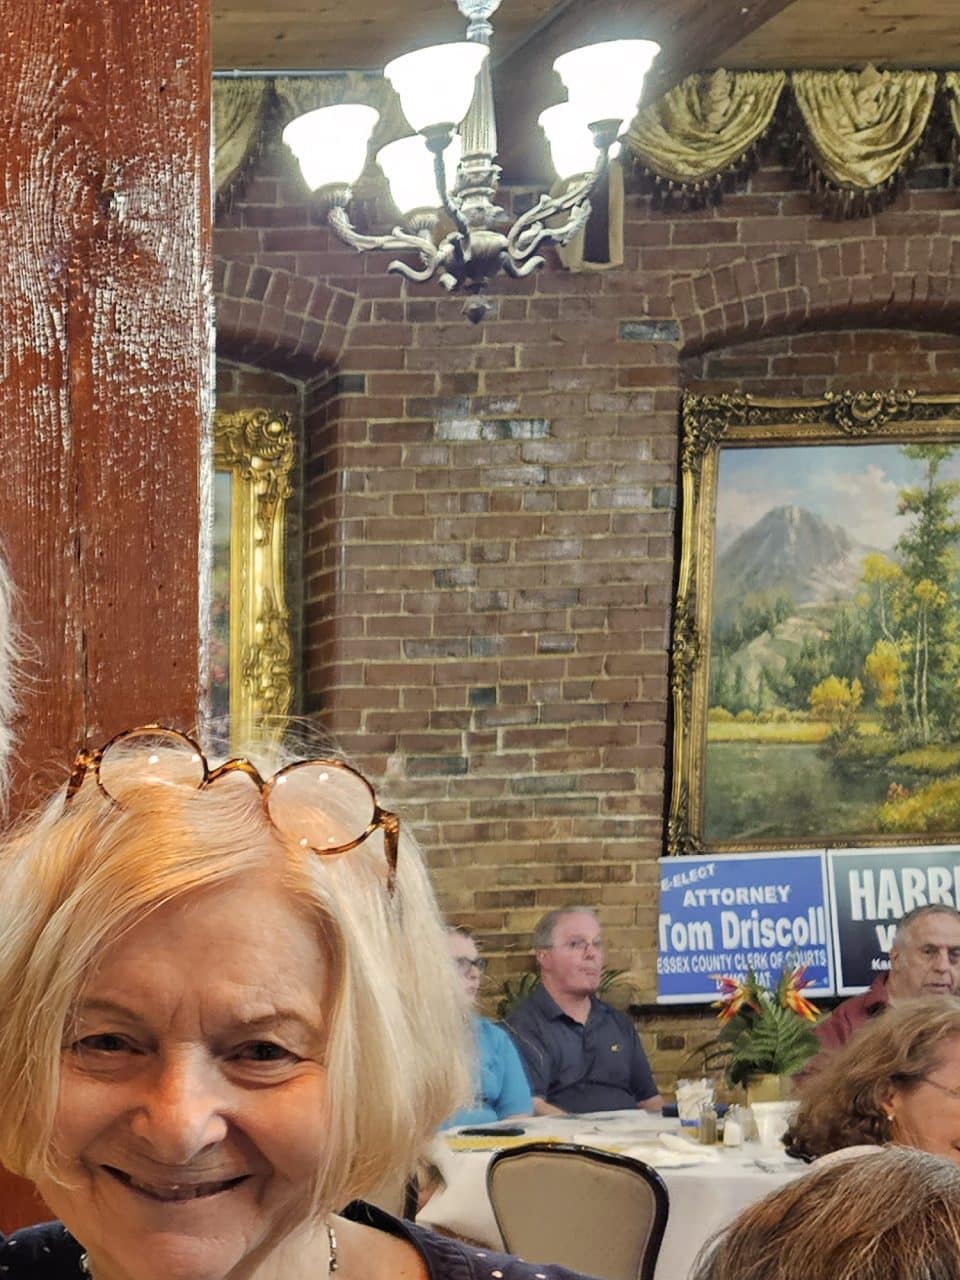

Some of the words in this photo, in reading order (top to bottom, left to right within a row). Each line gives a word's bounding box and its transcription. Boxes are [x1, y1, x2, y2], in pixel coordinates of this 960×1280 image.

[683, 885, 790, 907] ATTORNEY
[659, 912, 714, 952] Tom
[721, 906, 826, 949] Driscoll
[657, 956, 690, 974] ESSEX
[691, 954, 731, 973] COUNTY
[734, 952, 769, 970] CLERK
[770, 951, 784, 969] OF
